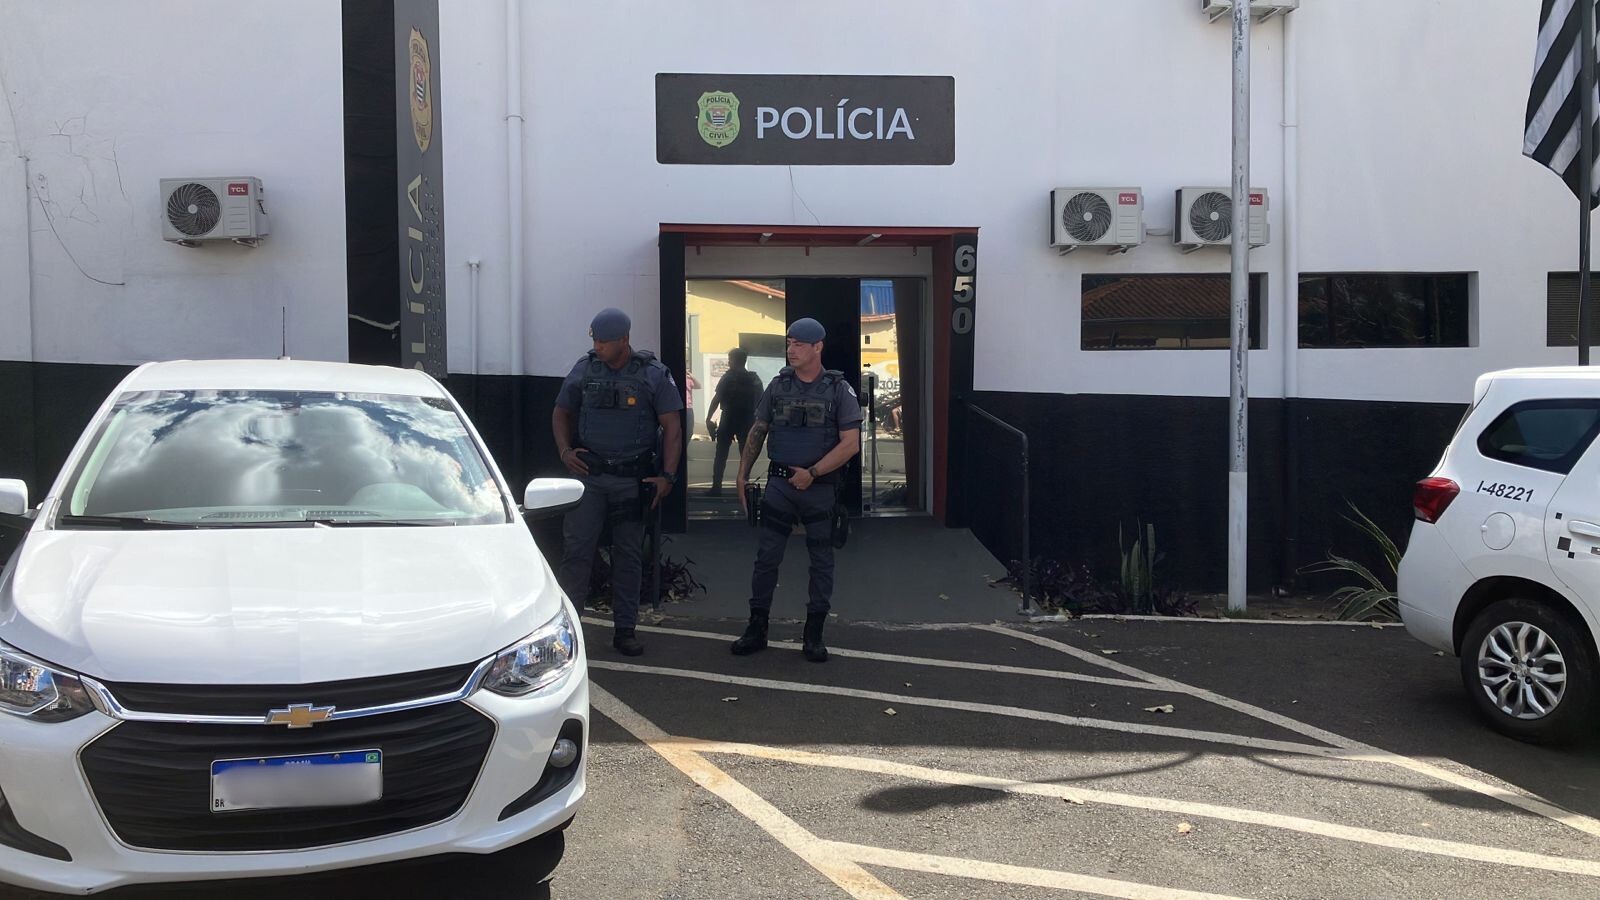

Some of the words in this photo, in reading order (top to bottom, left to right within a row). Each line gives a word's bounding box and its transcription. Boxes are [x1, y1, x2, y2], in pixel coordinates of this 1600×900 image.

[706, 96, 731, 105] POLÍCIA
[756, 98, 915, 140] POLÍCIA
[952, 244, 976, 335] 650
[1476, 480, 1534, 502] I-48221
[215, 799, 225, 808] BR
